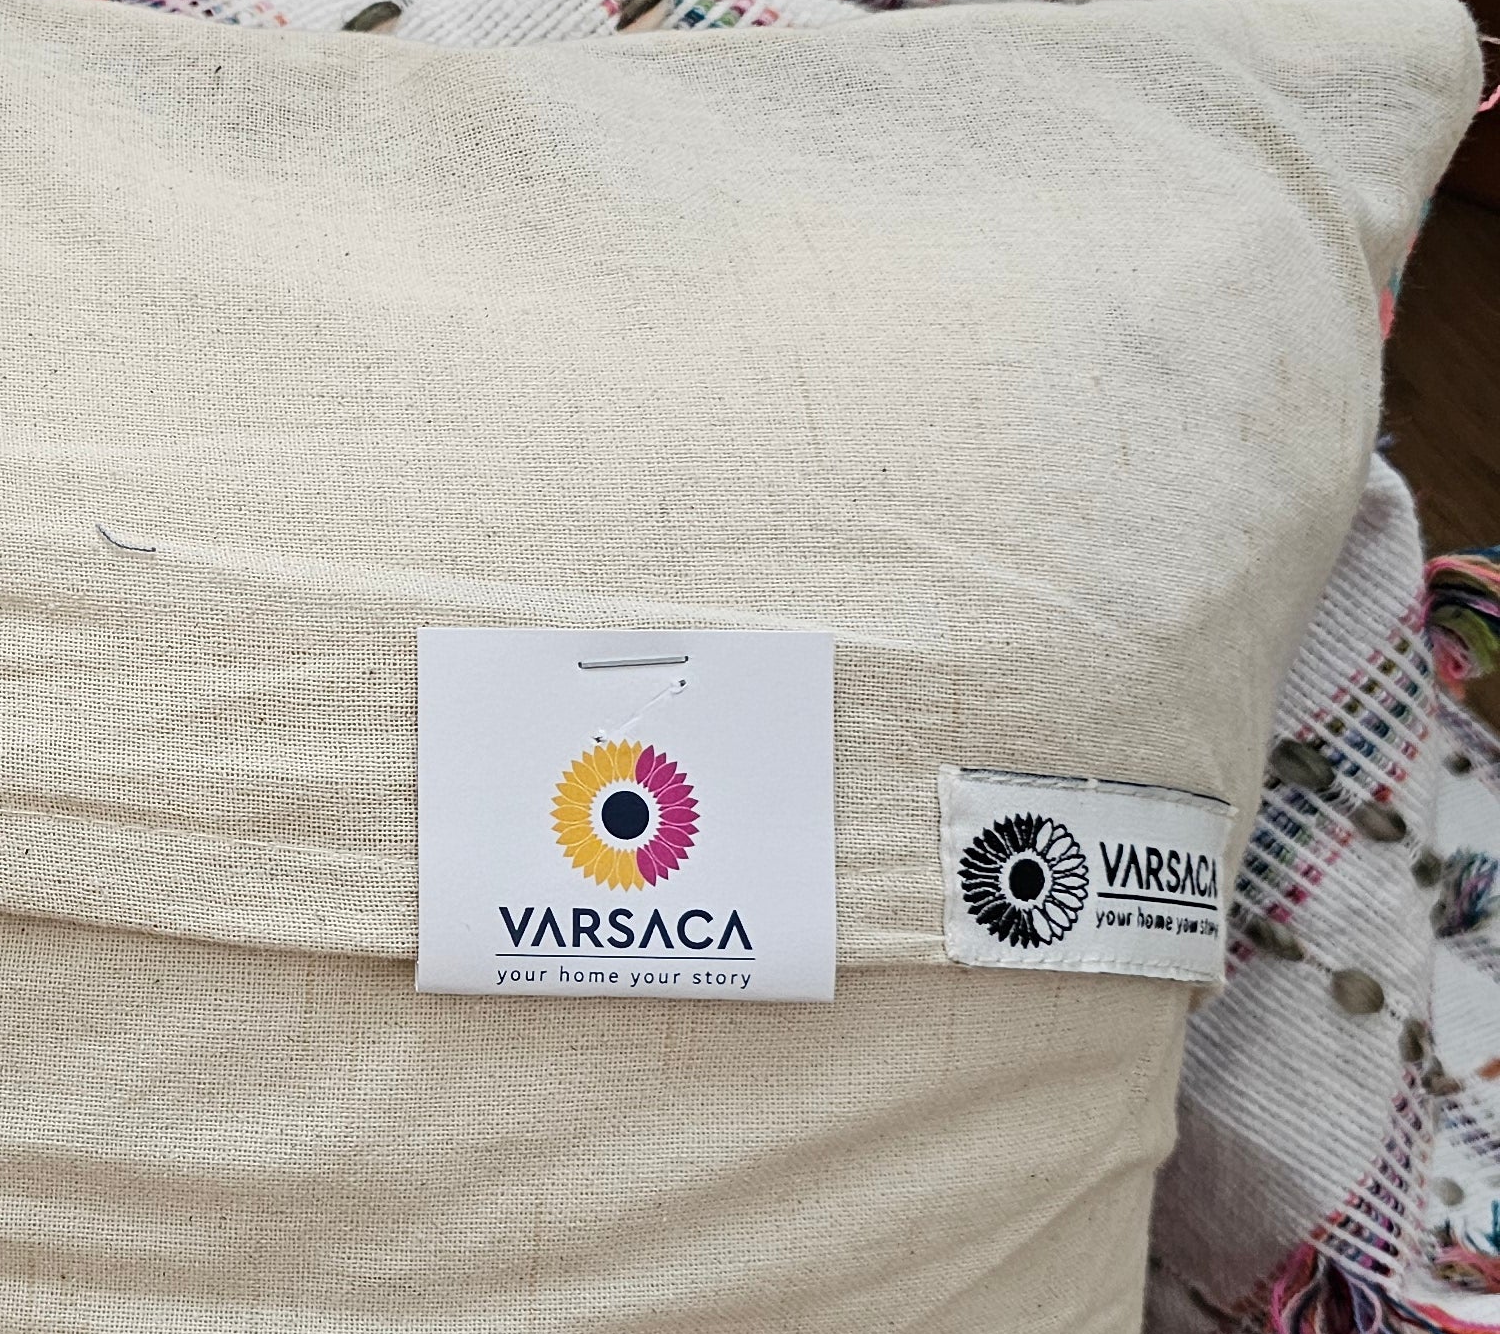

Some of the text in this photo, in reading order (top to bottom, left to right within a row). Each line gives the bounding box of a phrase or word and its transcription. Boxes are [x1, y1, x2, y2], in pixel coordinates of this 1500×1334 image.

[1099, 841, 1218, 899] VARSACA
[498, 906, 753, 950] VARSACA
[1096, 910, 1133, 929] your
[1137, 906, 1173, 931] home
[497, 966, 751, 989] your home your story
